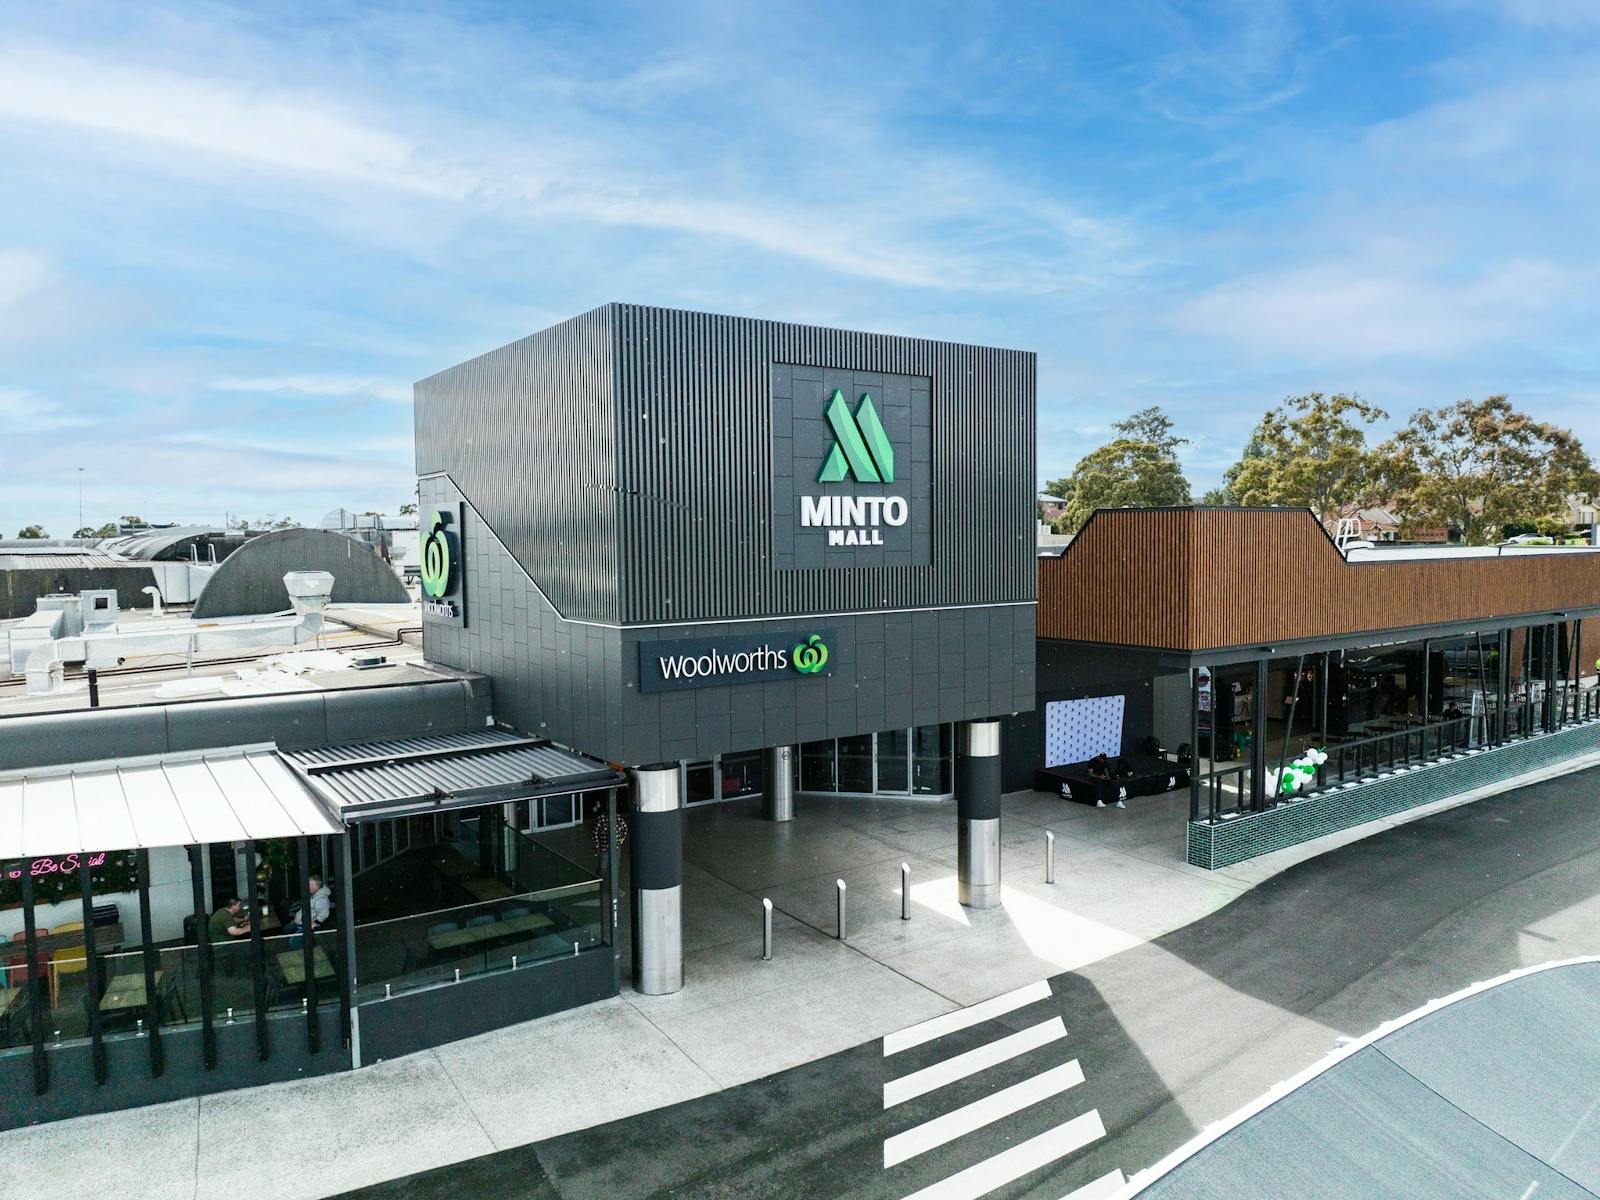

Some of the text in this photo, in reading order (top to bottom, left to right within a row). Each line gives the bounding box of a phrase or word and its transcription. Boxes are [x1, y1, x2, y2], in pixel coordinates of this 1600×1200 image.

[800, 495, 909, 527] MINTO
[828, 529, 884, 546] MALL
[659, 644, 788, 680] Woolworths
[30, 858, 58, 876] Be
